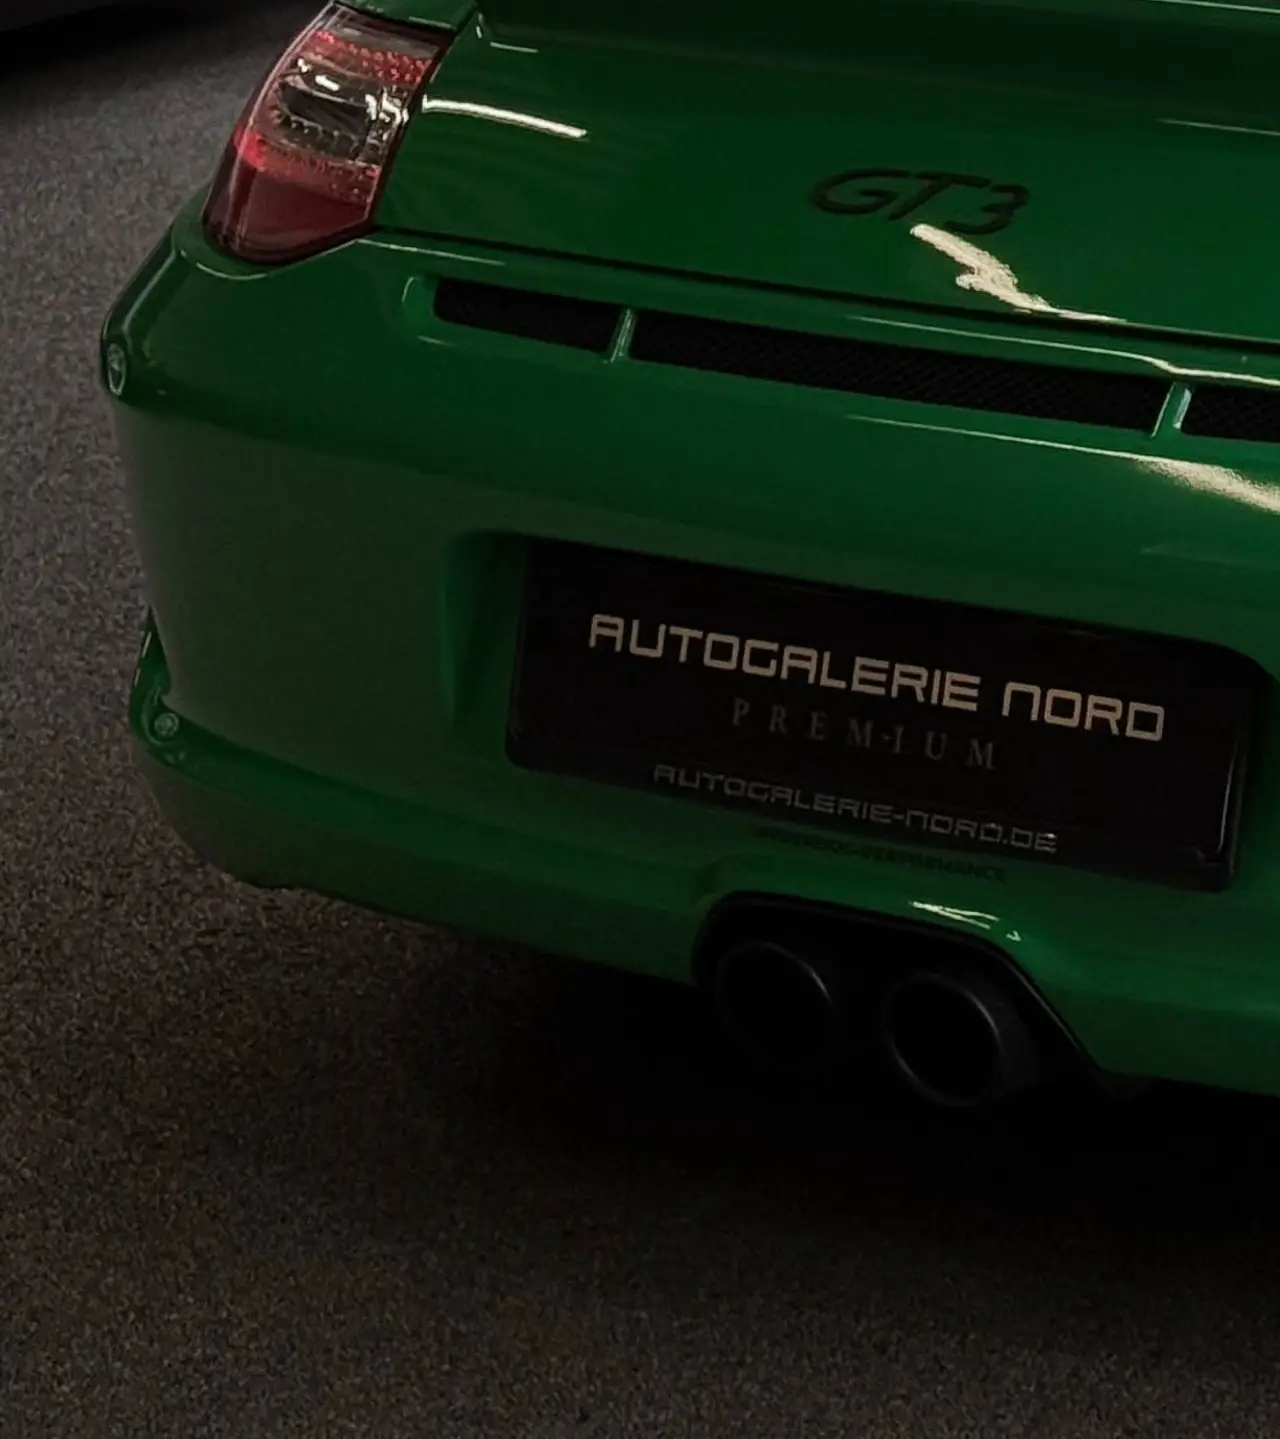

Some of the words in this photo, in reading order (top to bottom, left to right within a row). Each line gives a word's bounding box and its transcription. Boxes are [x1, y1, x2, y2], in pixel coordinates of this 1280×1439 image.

[812, 167, 1029, 235] GT3
[589, 613, 981, 712] AUTOGALERIE
[1002, 681, 1165, 742] NORD
[731, 698, 998, 770] PREMIUM
[653, 763, 1058, 854] AUTOGALERIE-NORD.DE
